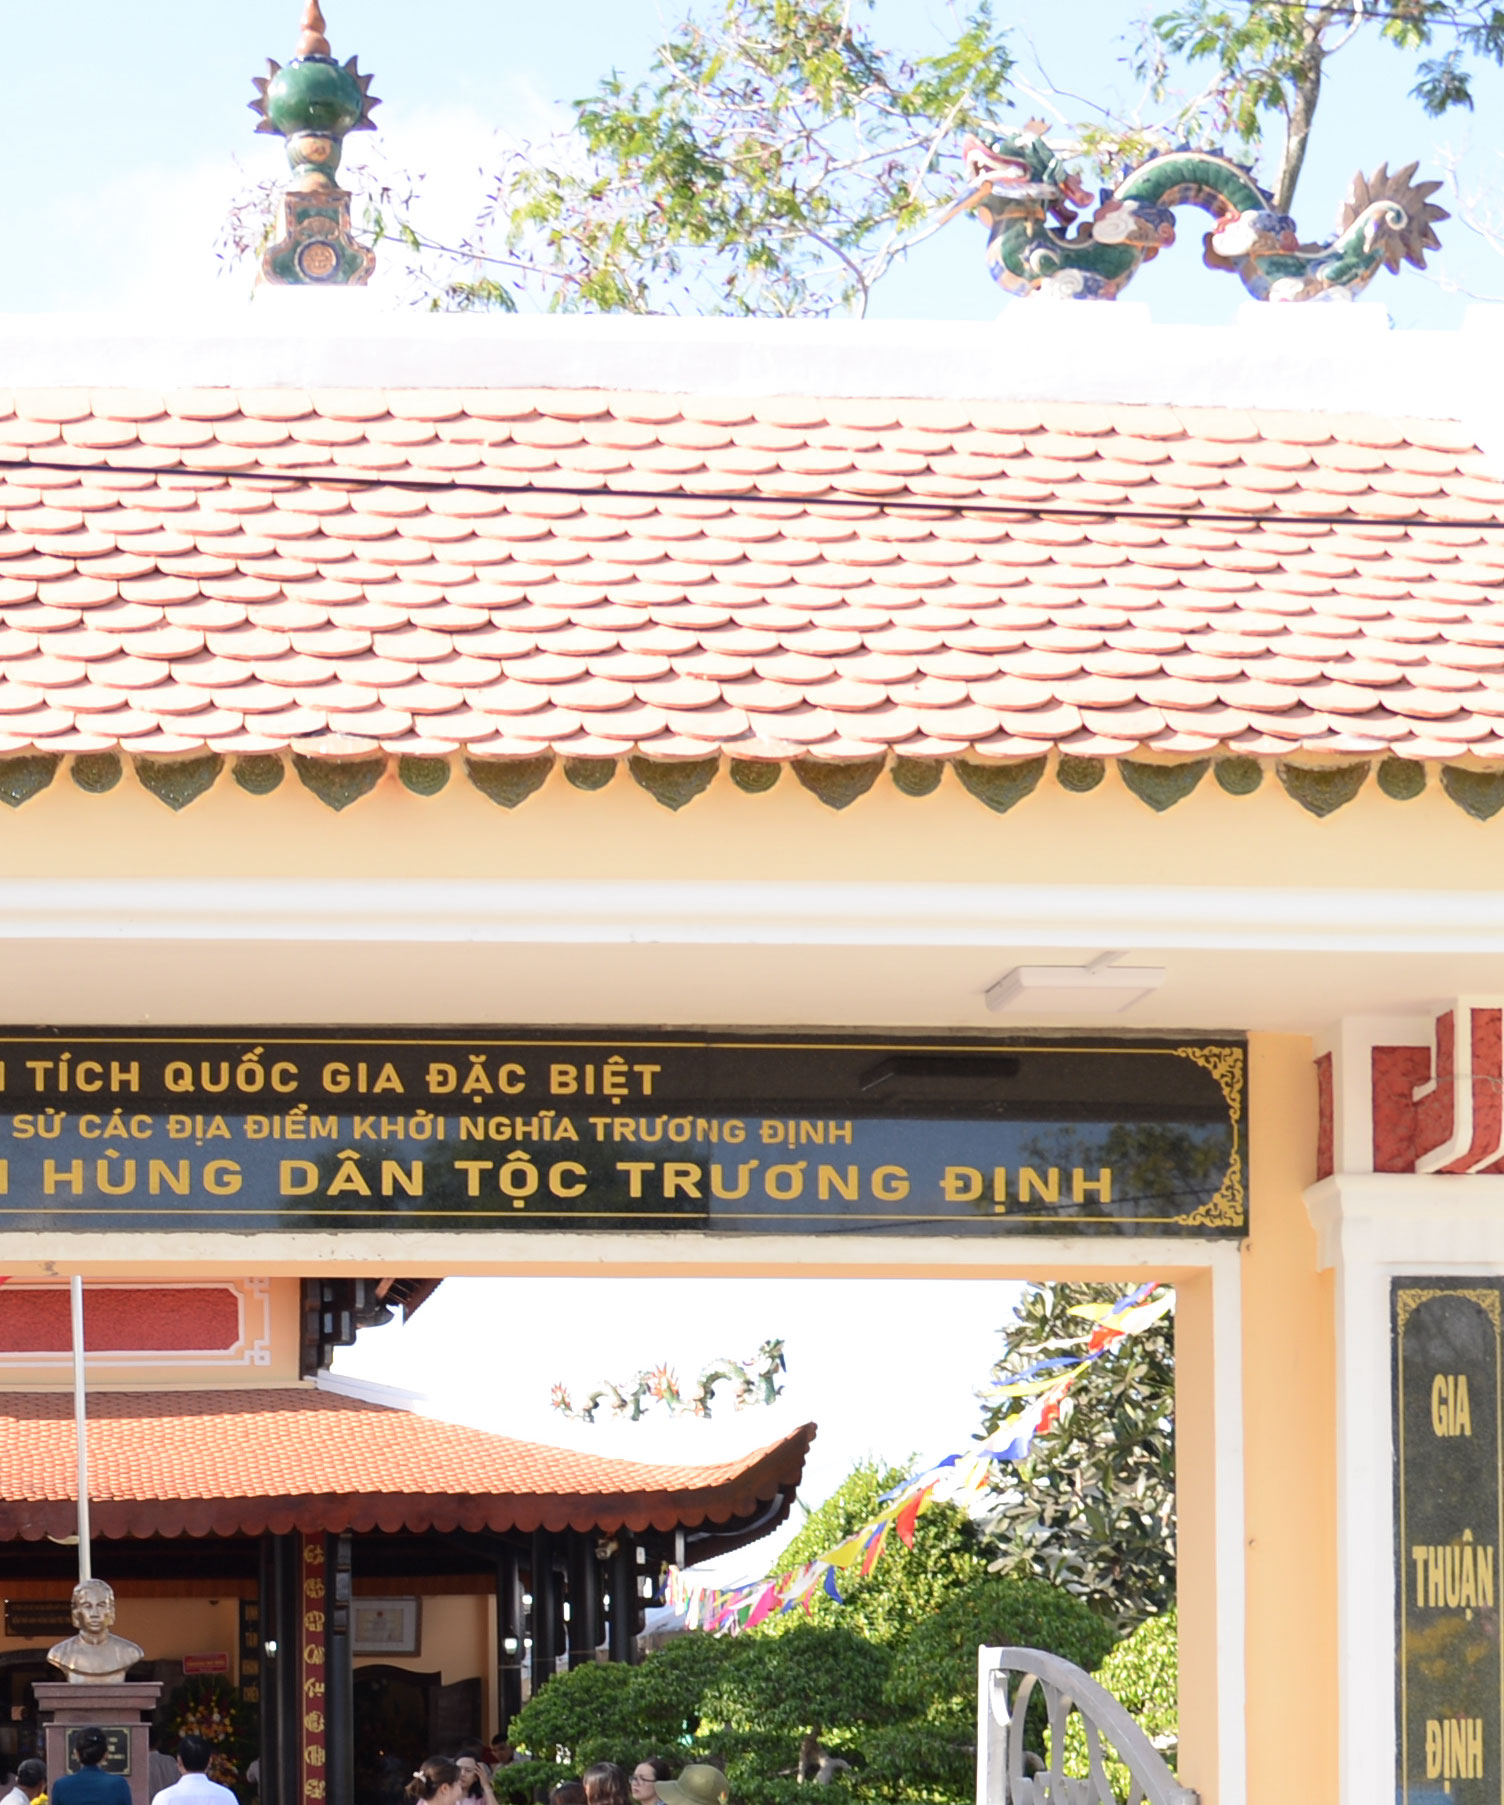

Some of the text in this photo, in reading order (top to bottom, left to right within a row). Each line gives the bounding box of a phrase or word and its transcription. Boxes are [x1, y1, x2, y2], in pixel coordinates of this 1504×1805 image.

[26, 1052, 139, 1092] TÍCH
[165, 1046, 298, 1093] QUỐC
[323, 1062, 404, 1094] GIA
[426, 1055, 525, 1104] ĐẶC
[550, 1056, 660, 1105] BIỆT
[13, 1107, 66, 1138] SỬ
[79, 1107, 152, 1139] CÁC
[168, 1115, 231, 1147] ĐỊA
[244, 1104, 338, 1140] ĐIỂM
[354, 1108, 444, 1141] KHỞI
[460, 1110, 578, 1142] NGHĨA
[589, 1115, 746, 1144] TRƯƠNG
[760, 1120, 852, 1150] ĐỊNH
[44, 1149, 242, 1196] HÙNG
[280, 1149, 422, 1197] DÂN
[454, 1150, 586, 1209] TỘC
[616, 1160, 910, 1202] TRƯƠNG
[941, 1166, 1112, 1214] ĐỊNH
[1432, 1374, 1472, 1438] GIA
[1412, 1529, 1494, 1623] THUẬN
[1425, 1718, 1483, 1794] ĐỊNH
